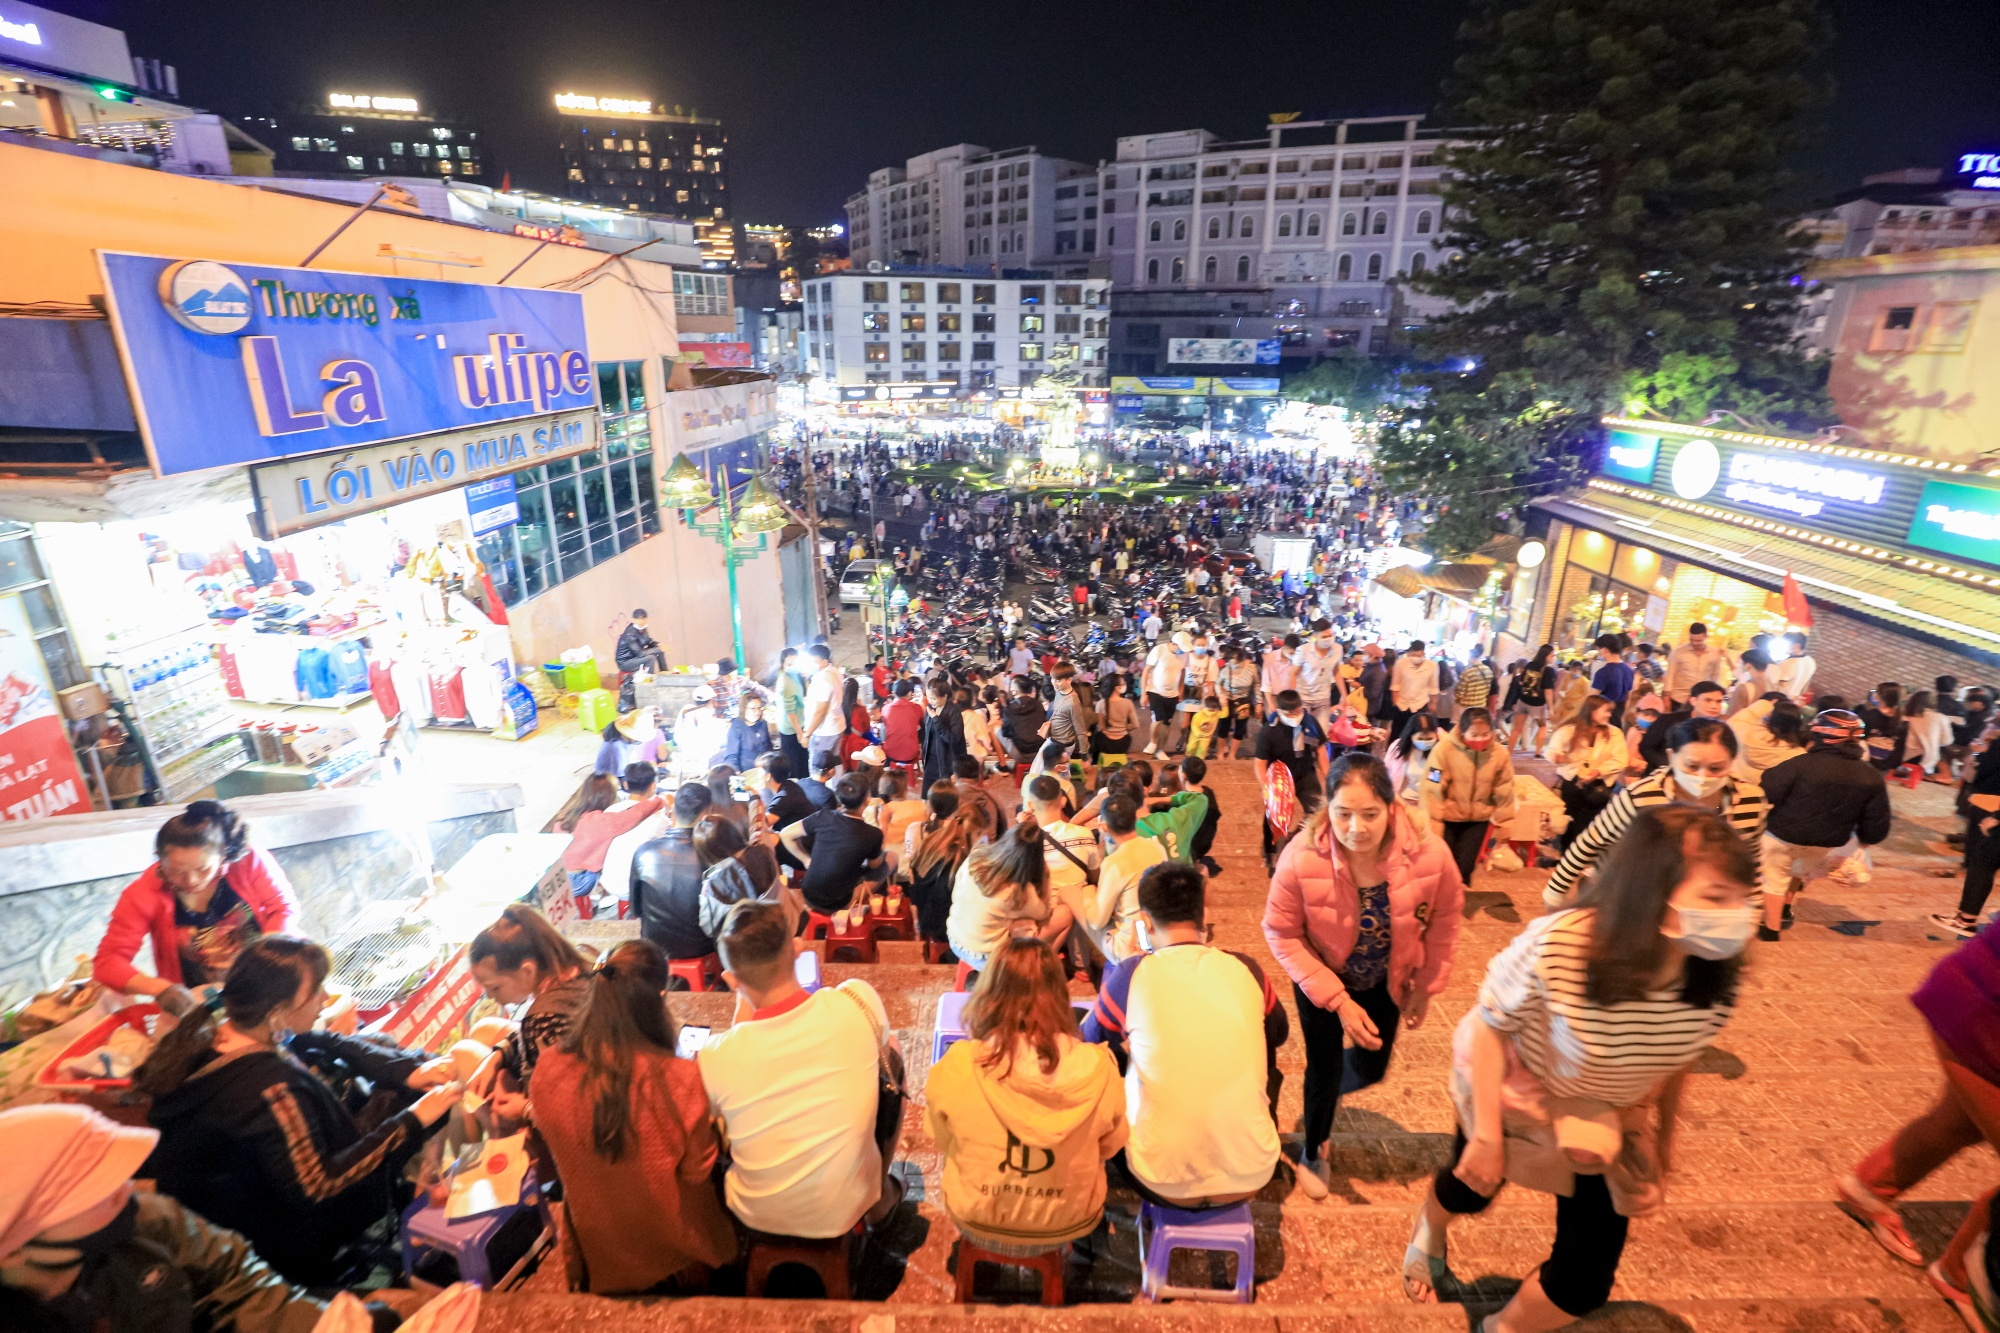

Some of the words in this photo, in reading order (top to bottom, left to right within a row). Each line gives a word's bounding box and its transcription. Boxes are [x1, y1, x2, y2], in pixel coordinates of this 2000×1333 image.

[251, 278, 379, 327] Thương
[240, 335, 388, 437] La
[296, 453, 374, 516] LỐI
[382, 446, 456, 491] VÀO
[463, 433, 528, 474] MUA
[980, 1183, 1065, 1199] BURBEARY
